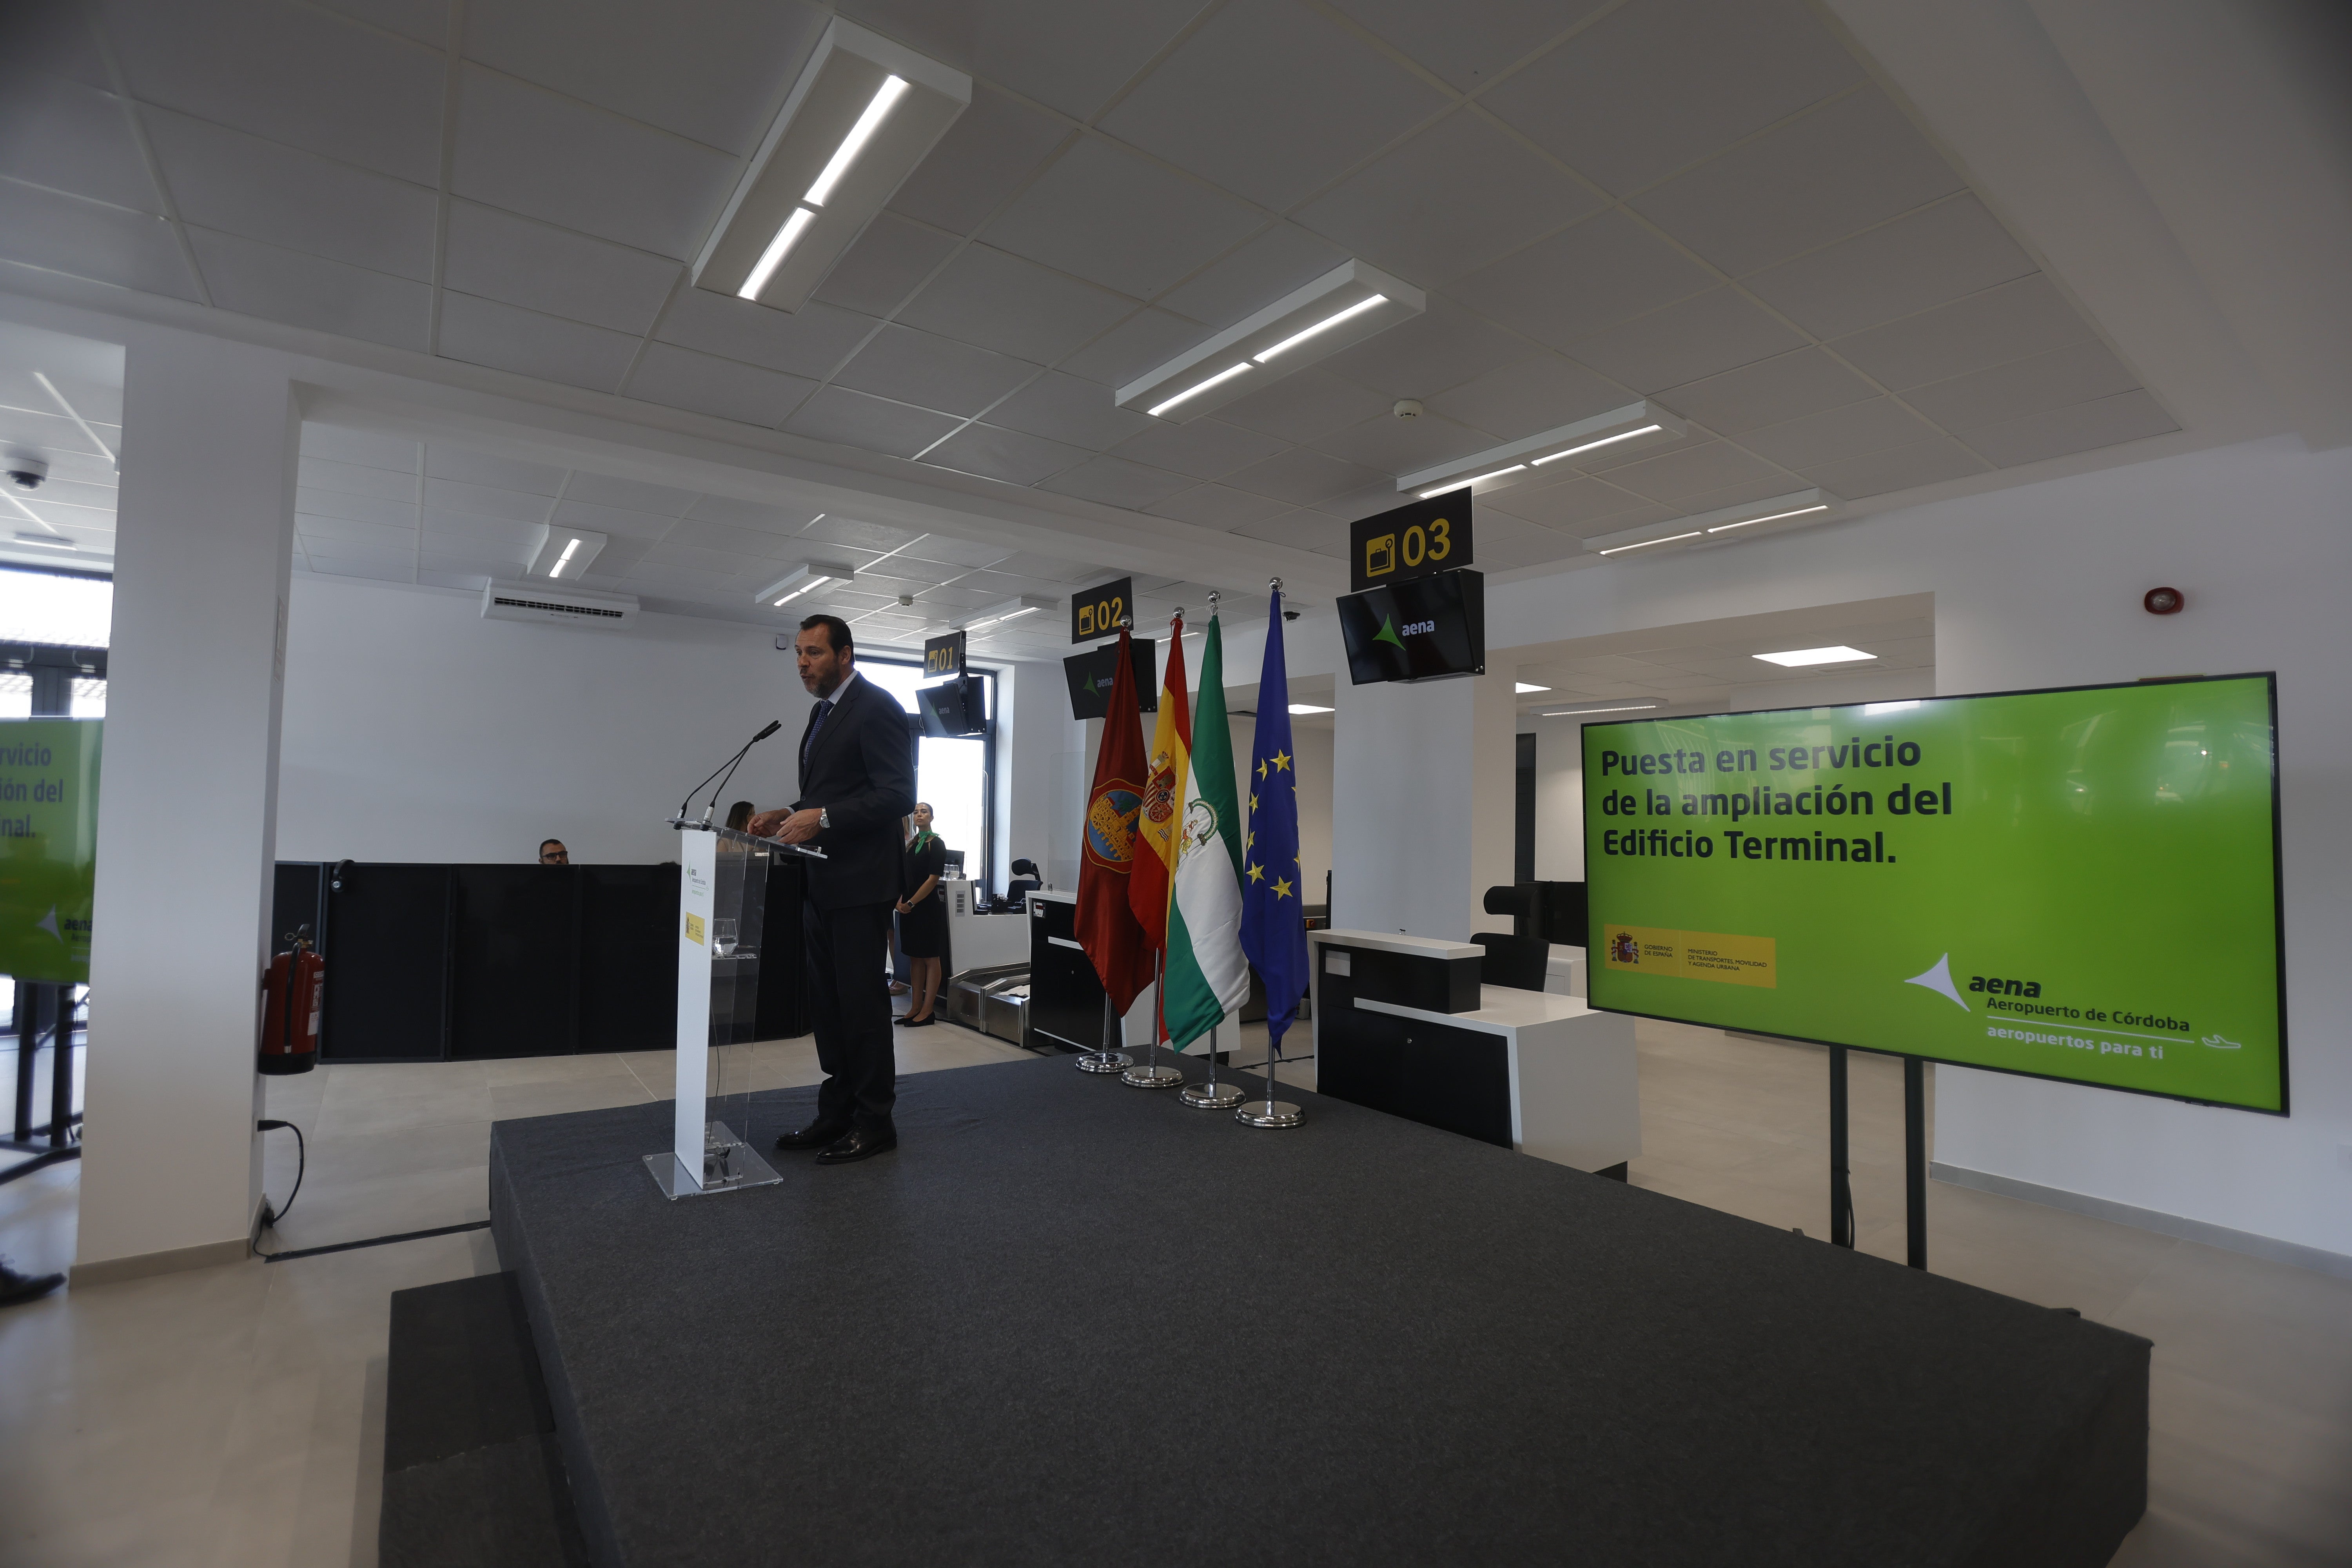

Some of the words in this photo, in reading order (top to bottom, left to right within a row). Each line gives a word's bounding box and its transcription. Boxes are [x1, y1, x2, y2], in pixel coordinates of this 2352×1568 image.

[1403, 518, 1450, 566] 03
[1098, 597, 1122, 630] 02
[1402, 620, 1435, 637] aena
[939, 647, 953, 671] 01
[1097, 677, 1113, 687] aena
[1602, 748, 1705, 776] Puesta
[1716, 749, 1757, 772] en
[1769, 735, 1921, 771] servicio
[34, 779, 63, 802] del
[1602, 789, 1637, 815] de
[1647, 788, 1671, 815] la
[1682, 784, 1873, 822] ampliación
[1887, 782, 1952, 815] del
[1604, 829, 1713, 858] Edificio
[1724, 831, 1896, 863] Terminal.
[1969, 976, 2042, 999] aena
[1987, 997, 2080, 1019] Aeropuerto
[2085, 1008, 2107, 1022] de
[2113, 1011, 2190, 1032] Córdoba
[1987, 1026, 2094, 1050] aeropuertos
[2101, 1041, 2143, 1057] para
[2149, 1045, 2163, 1059] ti
